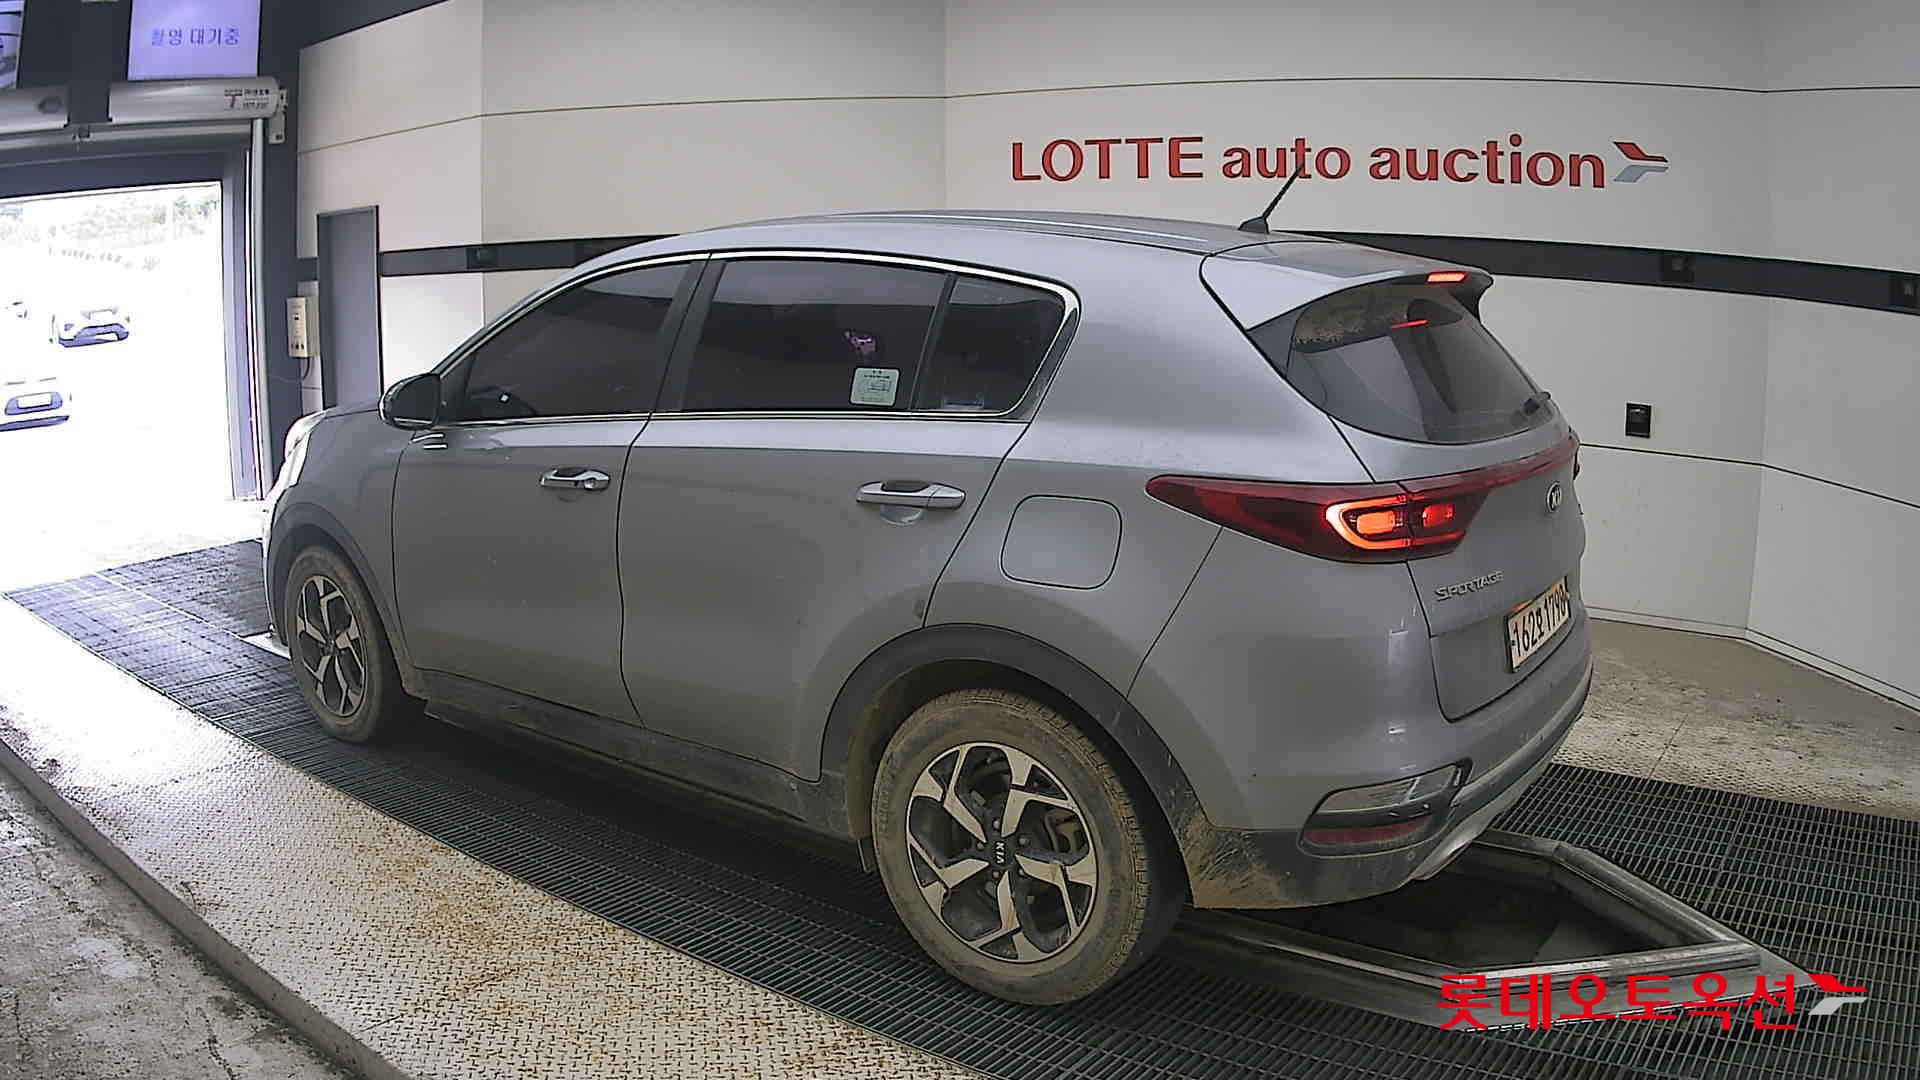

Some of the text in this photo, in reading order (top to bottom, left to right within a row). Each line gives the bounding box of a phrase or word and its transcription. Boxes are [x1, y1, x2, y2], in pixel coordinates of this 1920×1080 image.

[190, 28, 239, 46] 대기중
[1011, 134, 1606, 189] LOTTE auto auction
[1435, 571, 1504, 601] SPORTAGE
[995, 841, 1005, 864] KIA
